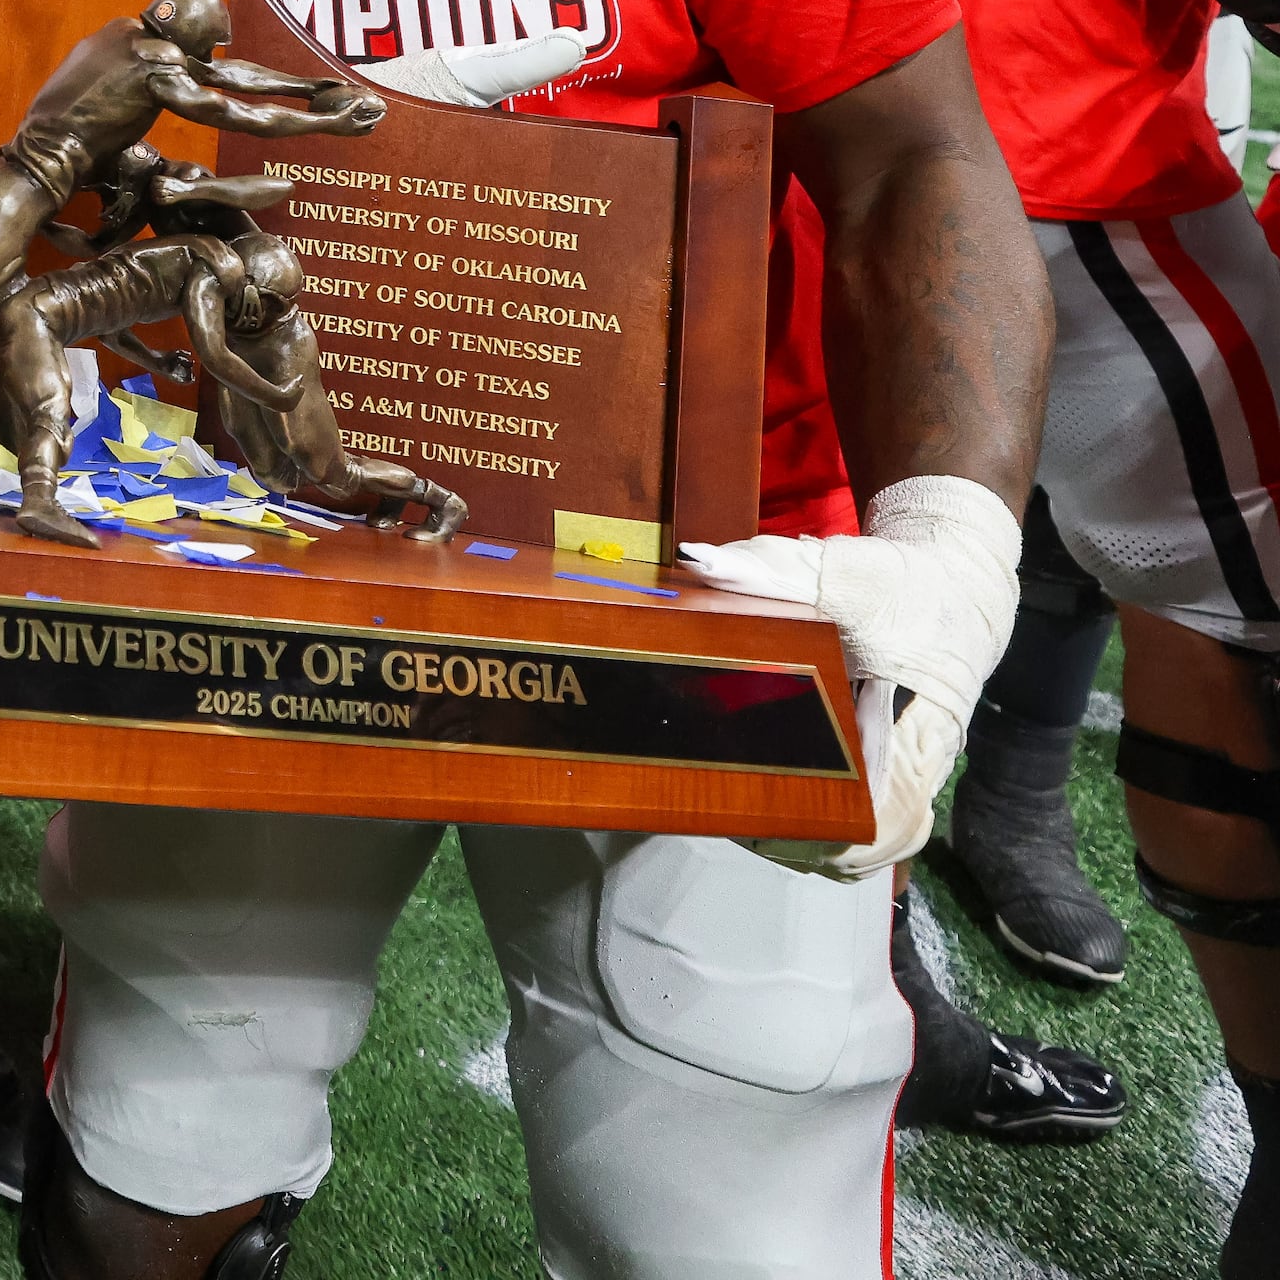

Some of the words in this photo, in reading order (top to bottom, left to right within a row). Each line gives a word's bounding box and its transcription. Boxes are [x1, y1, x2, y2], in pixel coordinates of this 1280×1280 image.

[263, 160, 391, 192] MISSISSIPPI
[397, 176, 467, 201] STATE
[473, 184, 613, 218] UNIVERSITY
[288, 200, 421, 232] UNIVERSITY
[426, 216, 459, 236] OF
[464, 221, 579, 252] MISSOURI
[413, 252, 446, 272] OF
[451, 257, 588, 291] OKLAHOMA
[302, 274, 370, 300] RSITY
[376, 284, 408, 305] OF
[413, 289, 494, 316] SOUTH
[501, 302, 623, 334] CAROLINA
[298, 311, 403, 343] IVERSITY
[409, 326, 441, 347] OF
[448, 332, 582, 367] TENNESSEE
[318, 351, 429, 383] NIVERSITY
[435, 367, 468, 388] OF
[474, 372, 551, 400] TEXAS
[359, 395, 414, 420] A&M
[420, 403, 560, 441] UNIVERSITY
[337, 428, 415, 457] ERBILT
[421, 444, 561, 480] UNIVERSITY
[302, 643, 367, 687] OF
[381, 649, 589, 707] GEORGIA
[196, 688, 262, 718] 2025
[270, 694, 412, 729] CHAMPION
